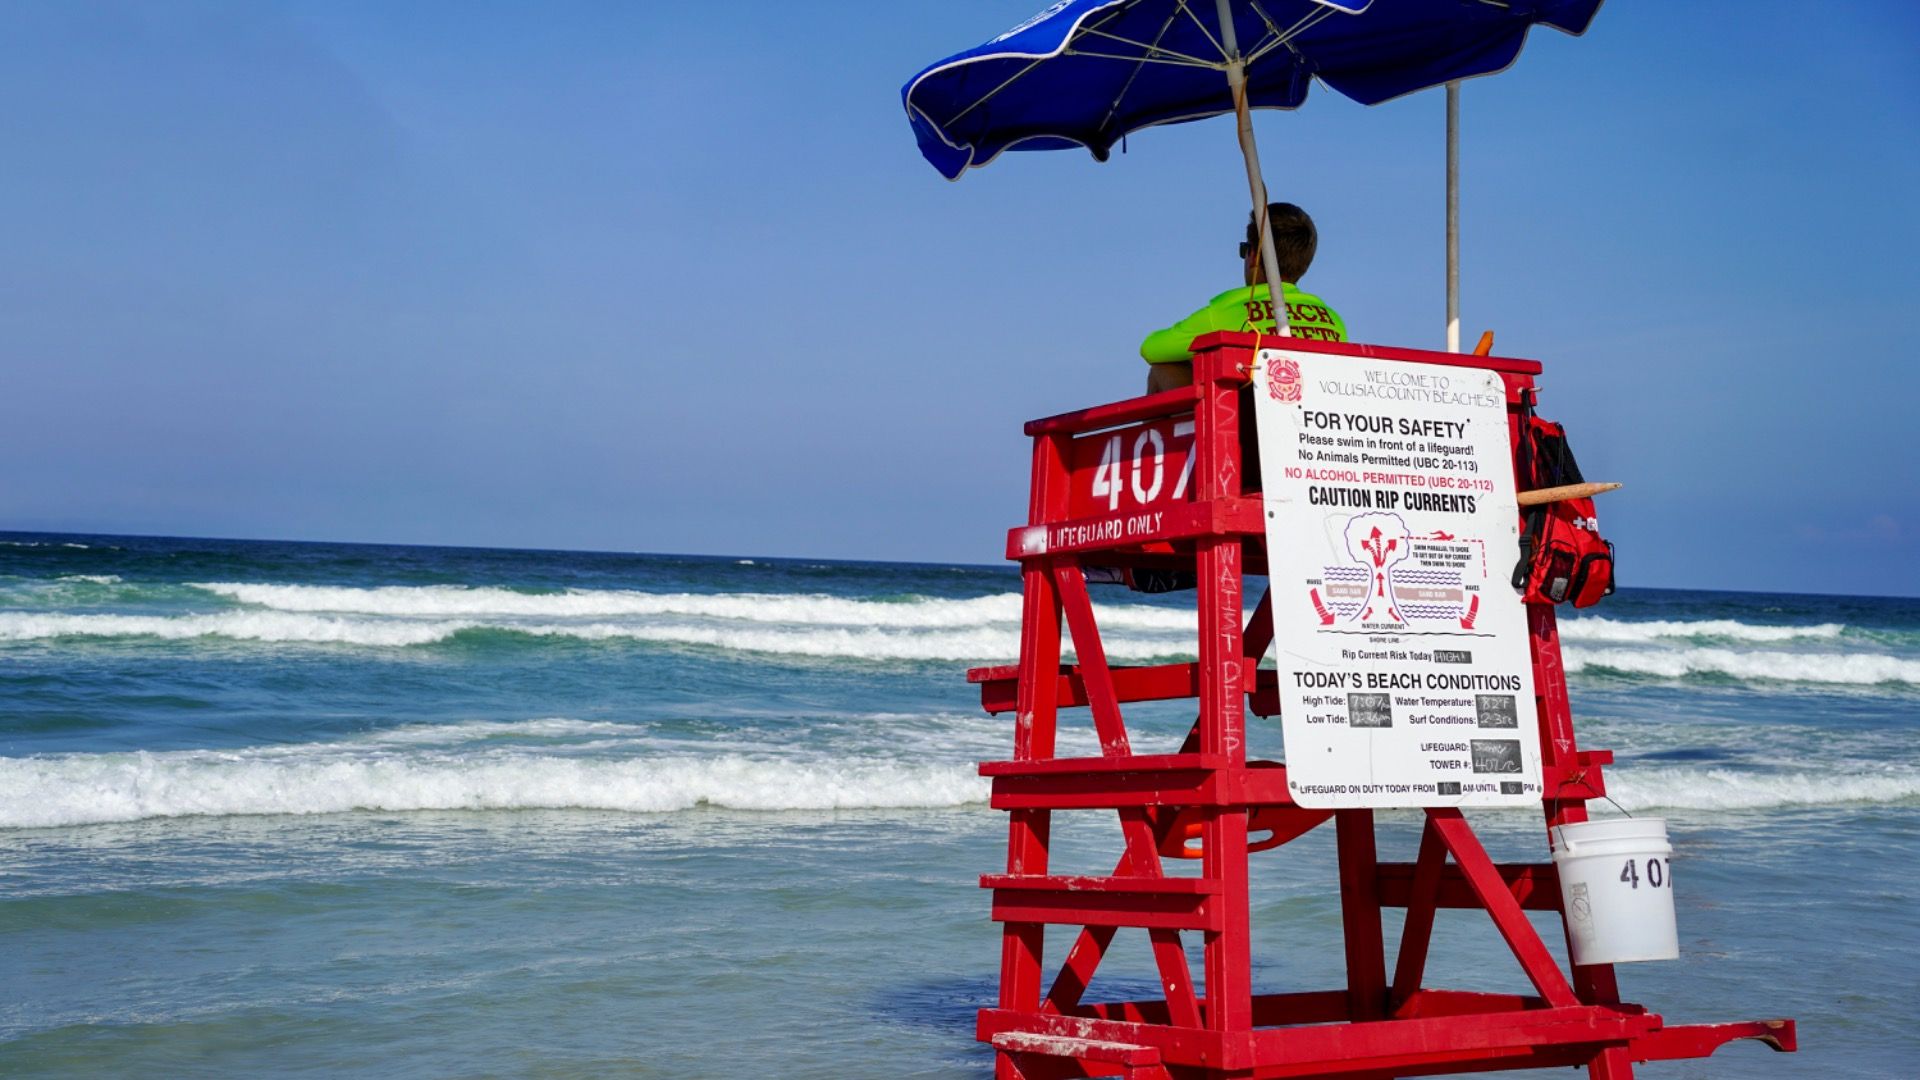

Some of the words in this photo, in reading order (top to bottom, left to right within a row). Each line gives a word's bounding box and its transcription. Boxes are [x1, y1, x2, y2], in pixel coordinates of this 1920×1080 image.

[1248, 326, 1340, 342] FETY
[1364, 370, 1428, 387] WELCOME
[1432, 376, 1450, 389] TO
[1320, 380, 1377, 398] VOLUSIA
[1377, 386, 1431, 402] COUNTY
[1304, 411, 1341, 430] FOR
[1344, 414, 1394, 434] YOUR
[1399, 418, 1465, 439] SAFETY
[1215, 390, 1238, 497] STAY
[1298, 433, 1334, 446] Please
[1337, 436, 1364, 448] swim
[1366, 438, 1376, 449] in
[1379, 439, 1403, 450] front
[1406, 441, 1416, 451] of
[1419, 443, 1425, 452] a
[1427, 442, 1474, 457] lifeguard!
[1092, 420, 1196, 511] 407
[1298, 449, 1314, 461] No
[1317, 450, 1359, 463] Animals
[1361, 453, 1411, 467] Permitted
[1413, 457, 1440, 470] (UBC
[1442, 459, 1478, 473] 20-113)
[1285, 467, 1302, 479] NO
[1306, 469, 1360, 483] ALCOHOL
[1362, 472, 1426, 487] PERMITTED
[1428, 475, 1455, 489] (UBC
[1457, 478, 1494, 493] 20-112)
[1309, 485, 1372, 508] CAUTION
[1375, 490, 1399, 509] RIP
[1404, 491, 1477, 514] CURRENTS
[1048, 519, 1122, 550] LIFEGUARD
[1127, 512, 1163, 535] ONLY
[1219, 546, 1238, 653] WAIST
[1342, 649, 1356, 660] Rip
[1358, 650, 1388, 660] Current
[1390, 650, 1407, 660] Risk
[1409, 651, 1432, 662] Today
[1293, 671, 1363, 689] TODAY'S
[1367, 673, 1421, 689] BEACH
[1426, 674, 1522, 691] CONDITIONS
[1302, 695, 1323, 707] High
[1324, 696, 1346, 706] Tide:
[1395, 697, 1420, 707] Water
[1421, 697, 1475, 709] Temperature:
[1221, 660, 1241, 764] DEEP
[1306, 714, 1325, 724] Low
[1326, 714, 1348, 724] Tide:
[1408, 714, 1426, 725] Surf
[1429, 715, 1477, 725] Conditions:
[1421, 743, 1470, 752] LIFEGUARD:
[1430, 760, 1460, 770] TOWER
[1463, 761, 1472, 770] #:
[1300, 784, 1347, 794] LIFEGUARD
[1348, 784, 1361, 794] ON
[1362, 784, 1384, 794] DUTY
[1385, 784, 1411, 793] TODAY
[1413, 784, 1436, 793] FROM
[1463, 783, 1474, 793] AM
[1475, 783, 1498, 793] UNTIL
[1524, 783, 1535, 792] PM
